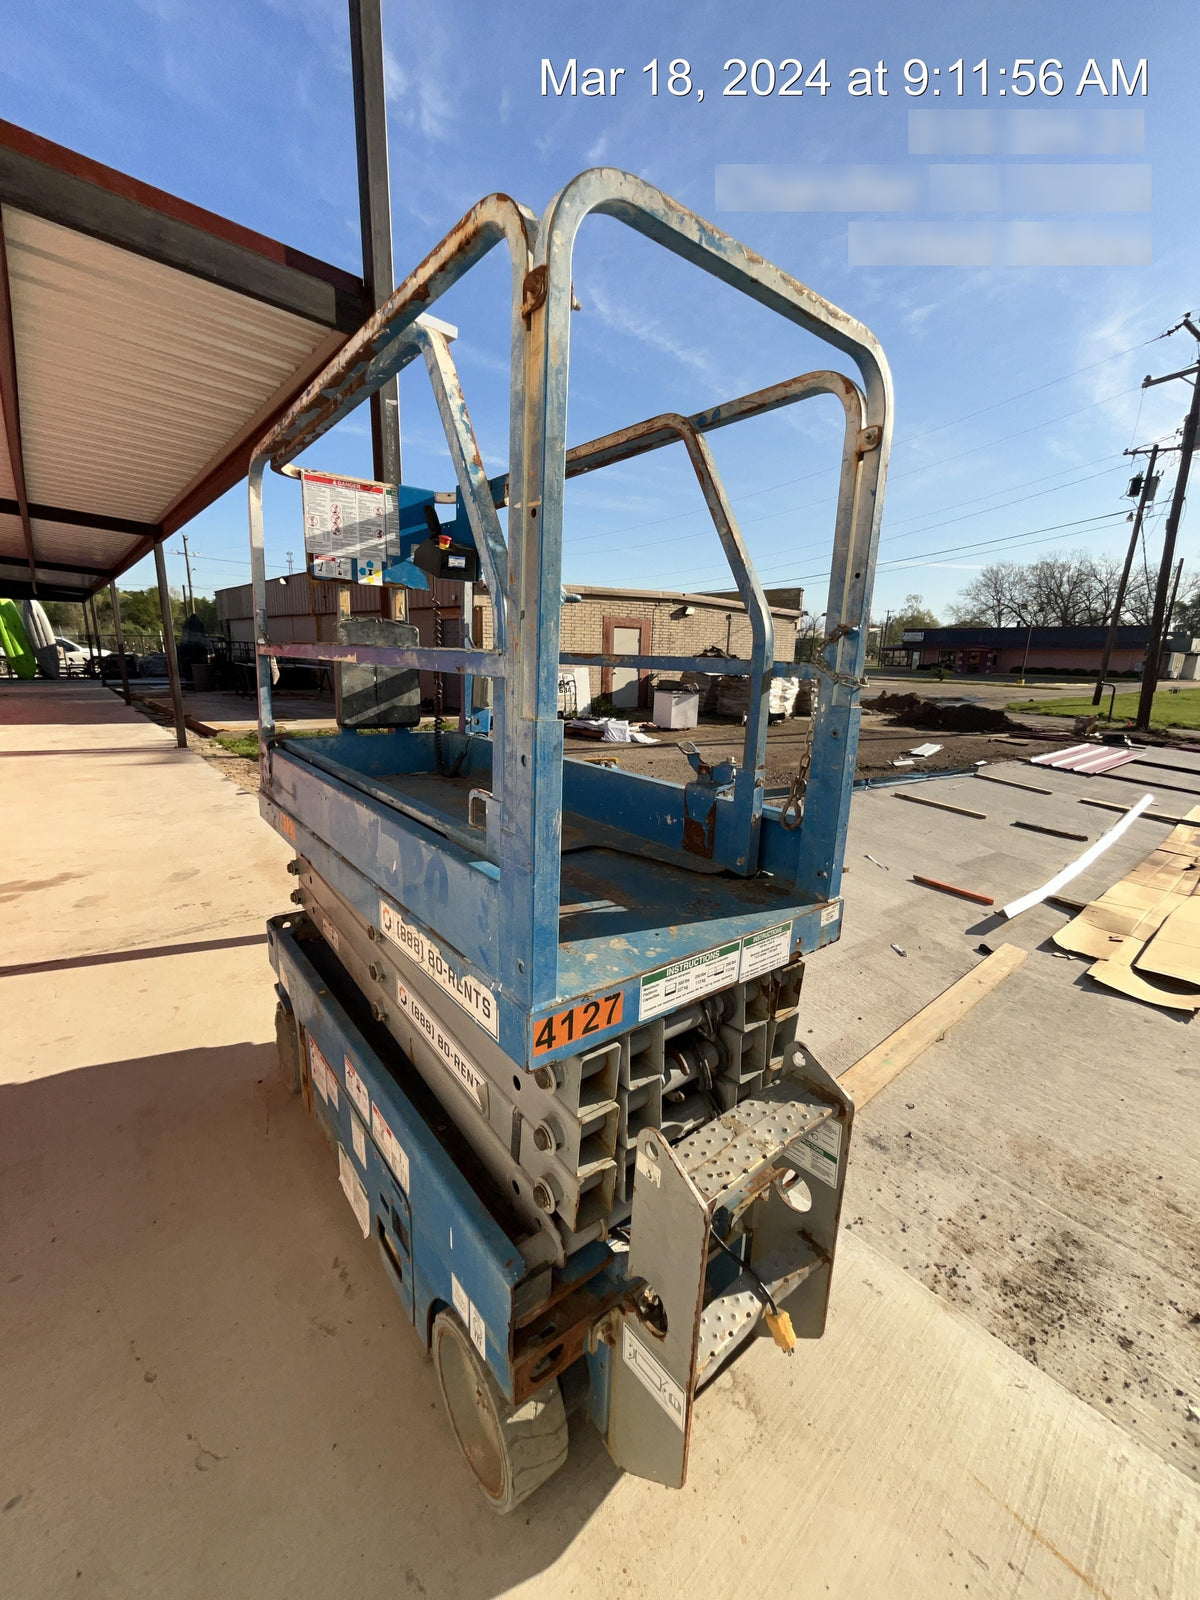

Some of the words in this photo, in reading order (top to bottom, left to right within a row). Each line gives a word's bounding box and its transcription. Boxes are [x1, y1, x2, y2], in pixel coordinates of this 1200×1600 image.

[337, 481, 361, 490] DANGER
[752, 926, 783, 943] INSTRUCTIONS
[396, 920, 425, 960] (888)
[427, 949, 492, 1020] 80-RENTS
[666, 950, 720, 977] INSTRUCTIONS
[411, 1001, 436, 1040] (888)
[535, 991, 622, 1049] 4127
